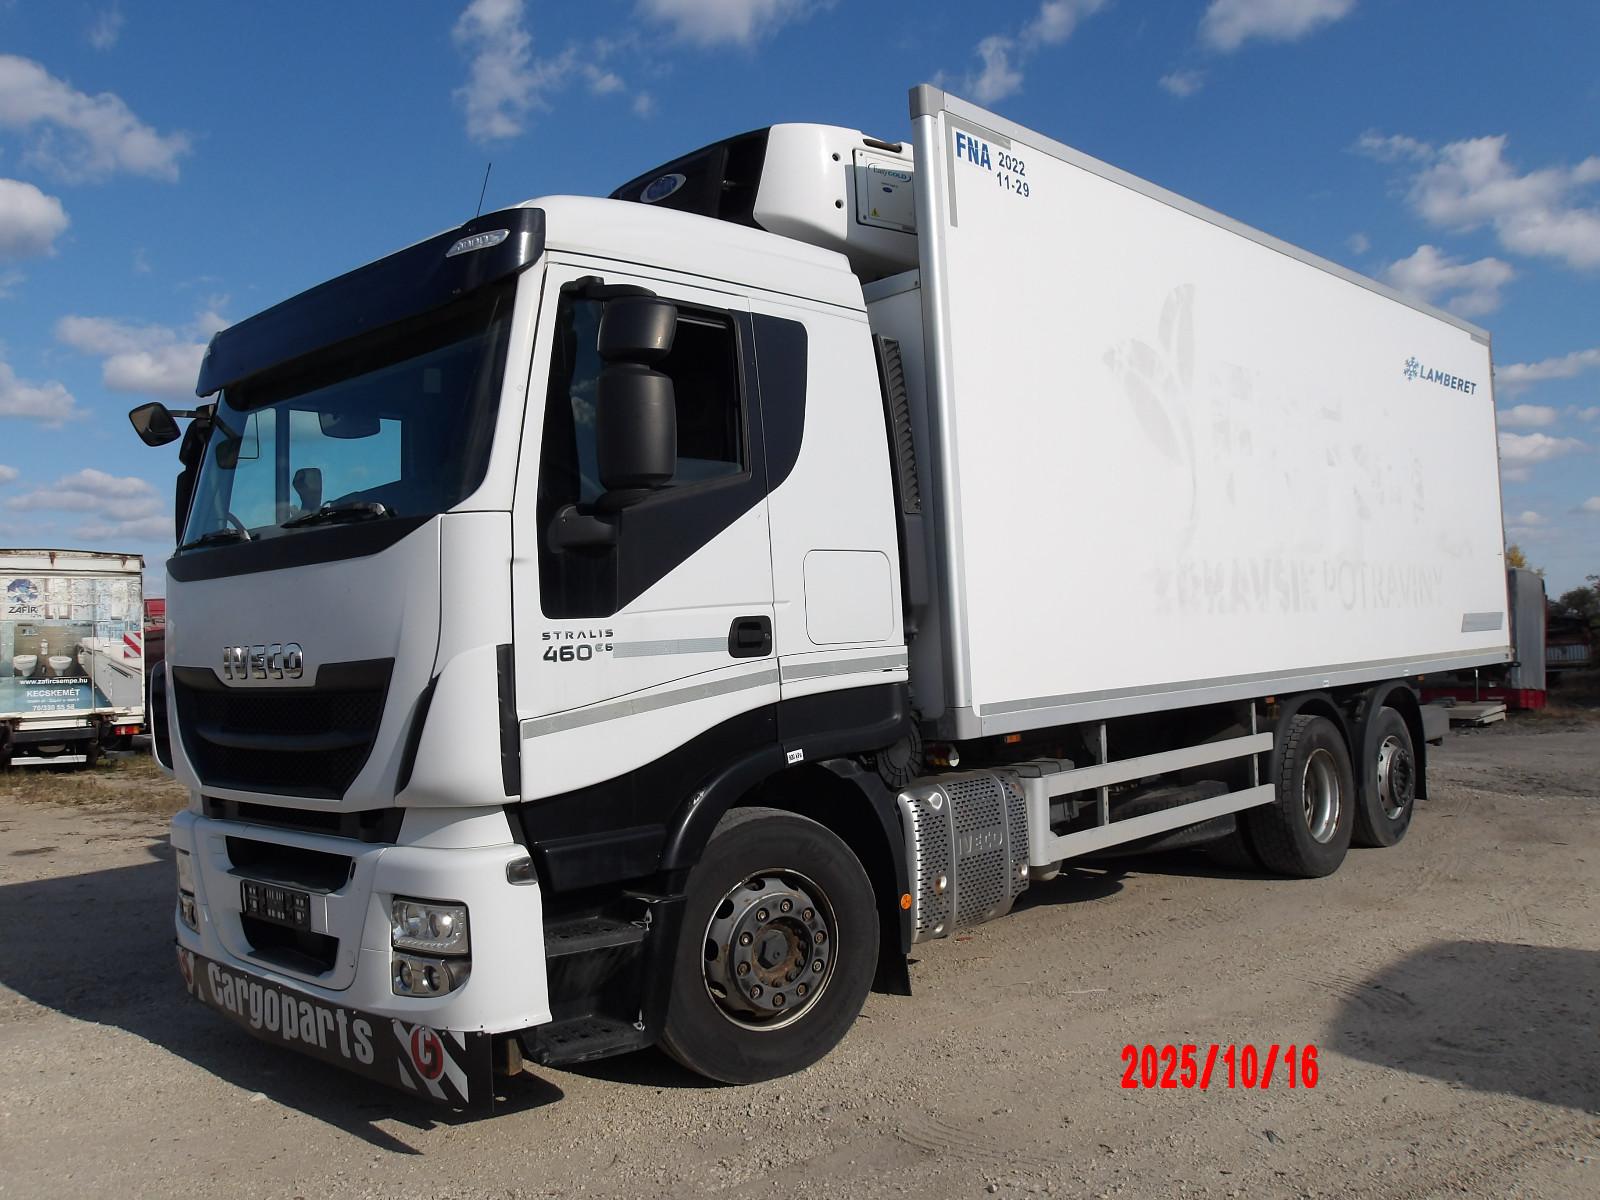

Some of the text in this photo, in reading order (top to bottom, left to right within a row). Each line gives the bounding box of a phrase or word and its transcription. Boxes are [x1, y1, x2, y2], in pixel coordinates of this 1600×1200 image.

[956, 131, 992, 171] FNA
[999, 151, 1026, 176] 2022
[997, 171, 1030, 198] 11-29
[1420, 364, 1477, 396] LAMBERET
[542, 629, 614, 641] STRALIS
[223, 642, 304, 680] IVECO
[26, 688, 80, 697] KECSKEMÉT
[208, 961, 375, 1065] Cargoparts
